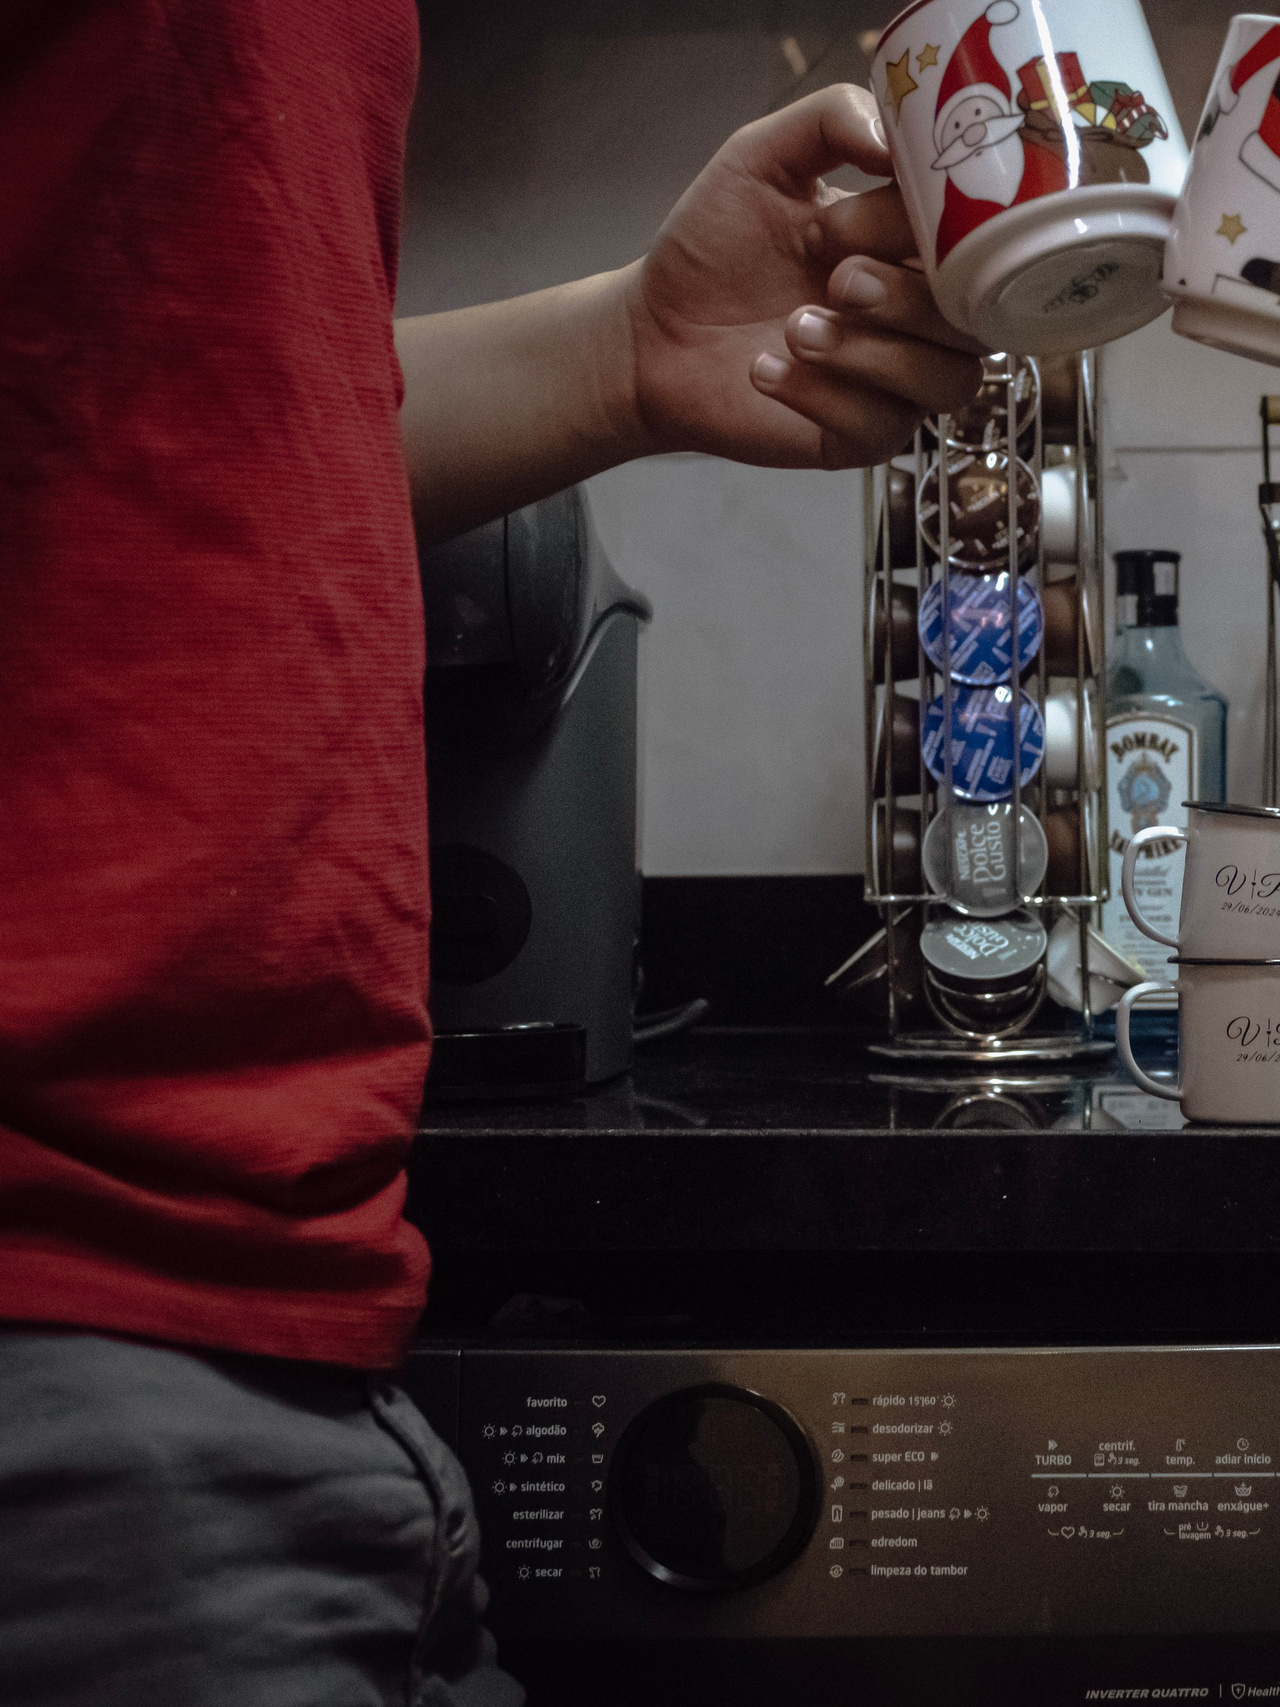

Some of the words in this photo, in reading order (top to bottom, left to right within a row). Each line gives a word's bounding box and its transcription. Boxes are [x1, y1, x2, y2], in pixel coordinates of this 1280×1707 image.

[1110, 732, 1179, 763] BOMBAY
[970, 823, 990, 884] Dolce
[526, 1396, 568, 1408] favorito
[872, 1395, 906, 1409] rápido
[525, 1424, 567, 1437] algodão
[872, 1423, 934, 1434] desodorizar
[1098, 1440, 1136, 1452] centrif.
[546, 1453, 566, 1464] mix
[872, 1452, 902, 1465] super
[904, 1451, 925, 1462] ECO
[1035, 1455, 1072, 1466] TURBO
[1165, 1455, 1196, 1467] temp.
[1215, 1453, 1242, 1465] adiar
[1243, 1453, 1271, 1465] início
[521, 1480, 566, 1493] sintético
[871, 1480, 916, 1491] delicado
[923, 1480, 933, 1491] lã
[1038, 1502, 1068, 1514] vapor
[1103, 1501, 1131, 1512] secar
[1148, 1500, 1166, 1511] tira
[1168, 1500, 1209, 1511] mancha
[512, 1508, 565, 1520] esterilizar
[871, 1508, 909, 1521] pesado
[917, 1508, 946, 1521] jeans
[1179, 1521, 1192, 1533] pré
[871, 1536, 918, 1547] edredom
[1179, 1530, 1211, 1541] lavagem
[506, 1537, 563, 1551] centrifugar
[535, 1568, 563, 1578] secar
[870, 1565, 912, 1578] limpeza
[914, 1565, 928, 1576] do
[930, 1565, 968, 1576] tambor
[1085, 1688, 1150, 1700] INVERTER
[1151, 1687, 1209, 1699] QUATTRO
